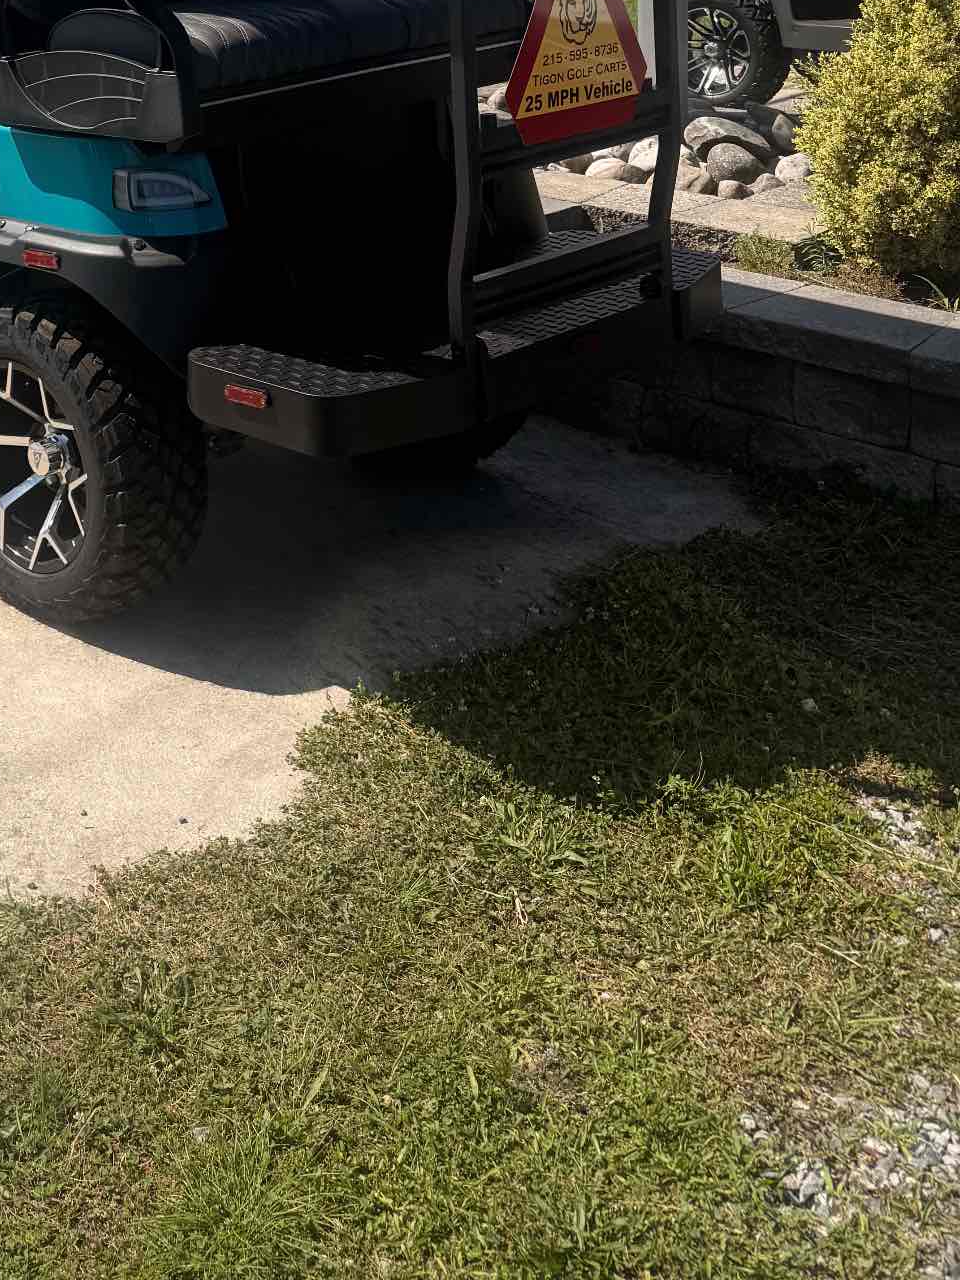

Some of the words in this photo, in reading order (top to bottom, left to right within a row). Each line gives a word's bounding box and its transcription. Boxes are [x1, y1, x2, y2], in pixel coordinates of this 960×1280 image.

[533, 74, 565, 88] TIGON
[567, 66, 594, 81] GOLF
[596, 61, 628, 76] CARTS
[525, 95, 543, 113] 25
[548, 87, 580, 108] MPH
[584, 78, 633, 100] Vehicle
